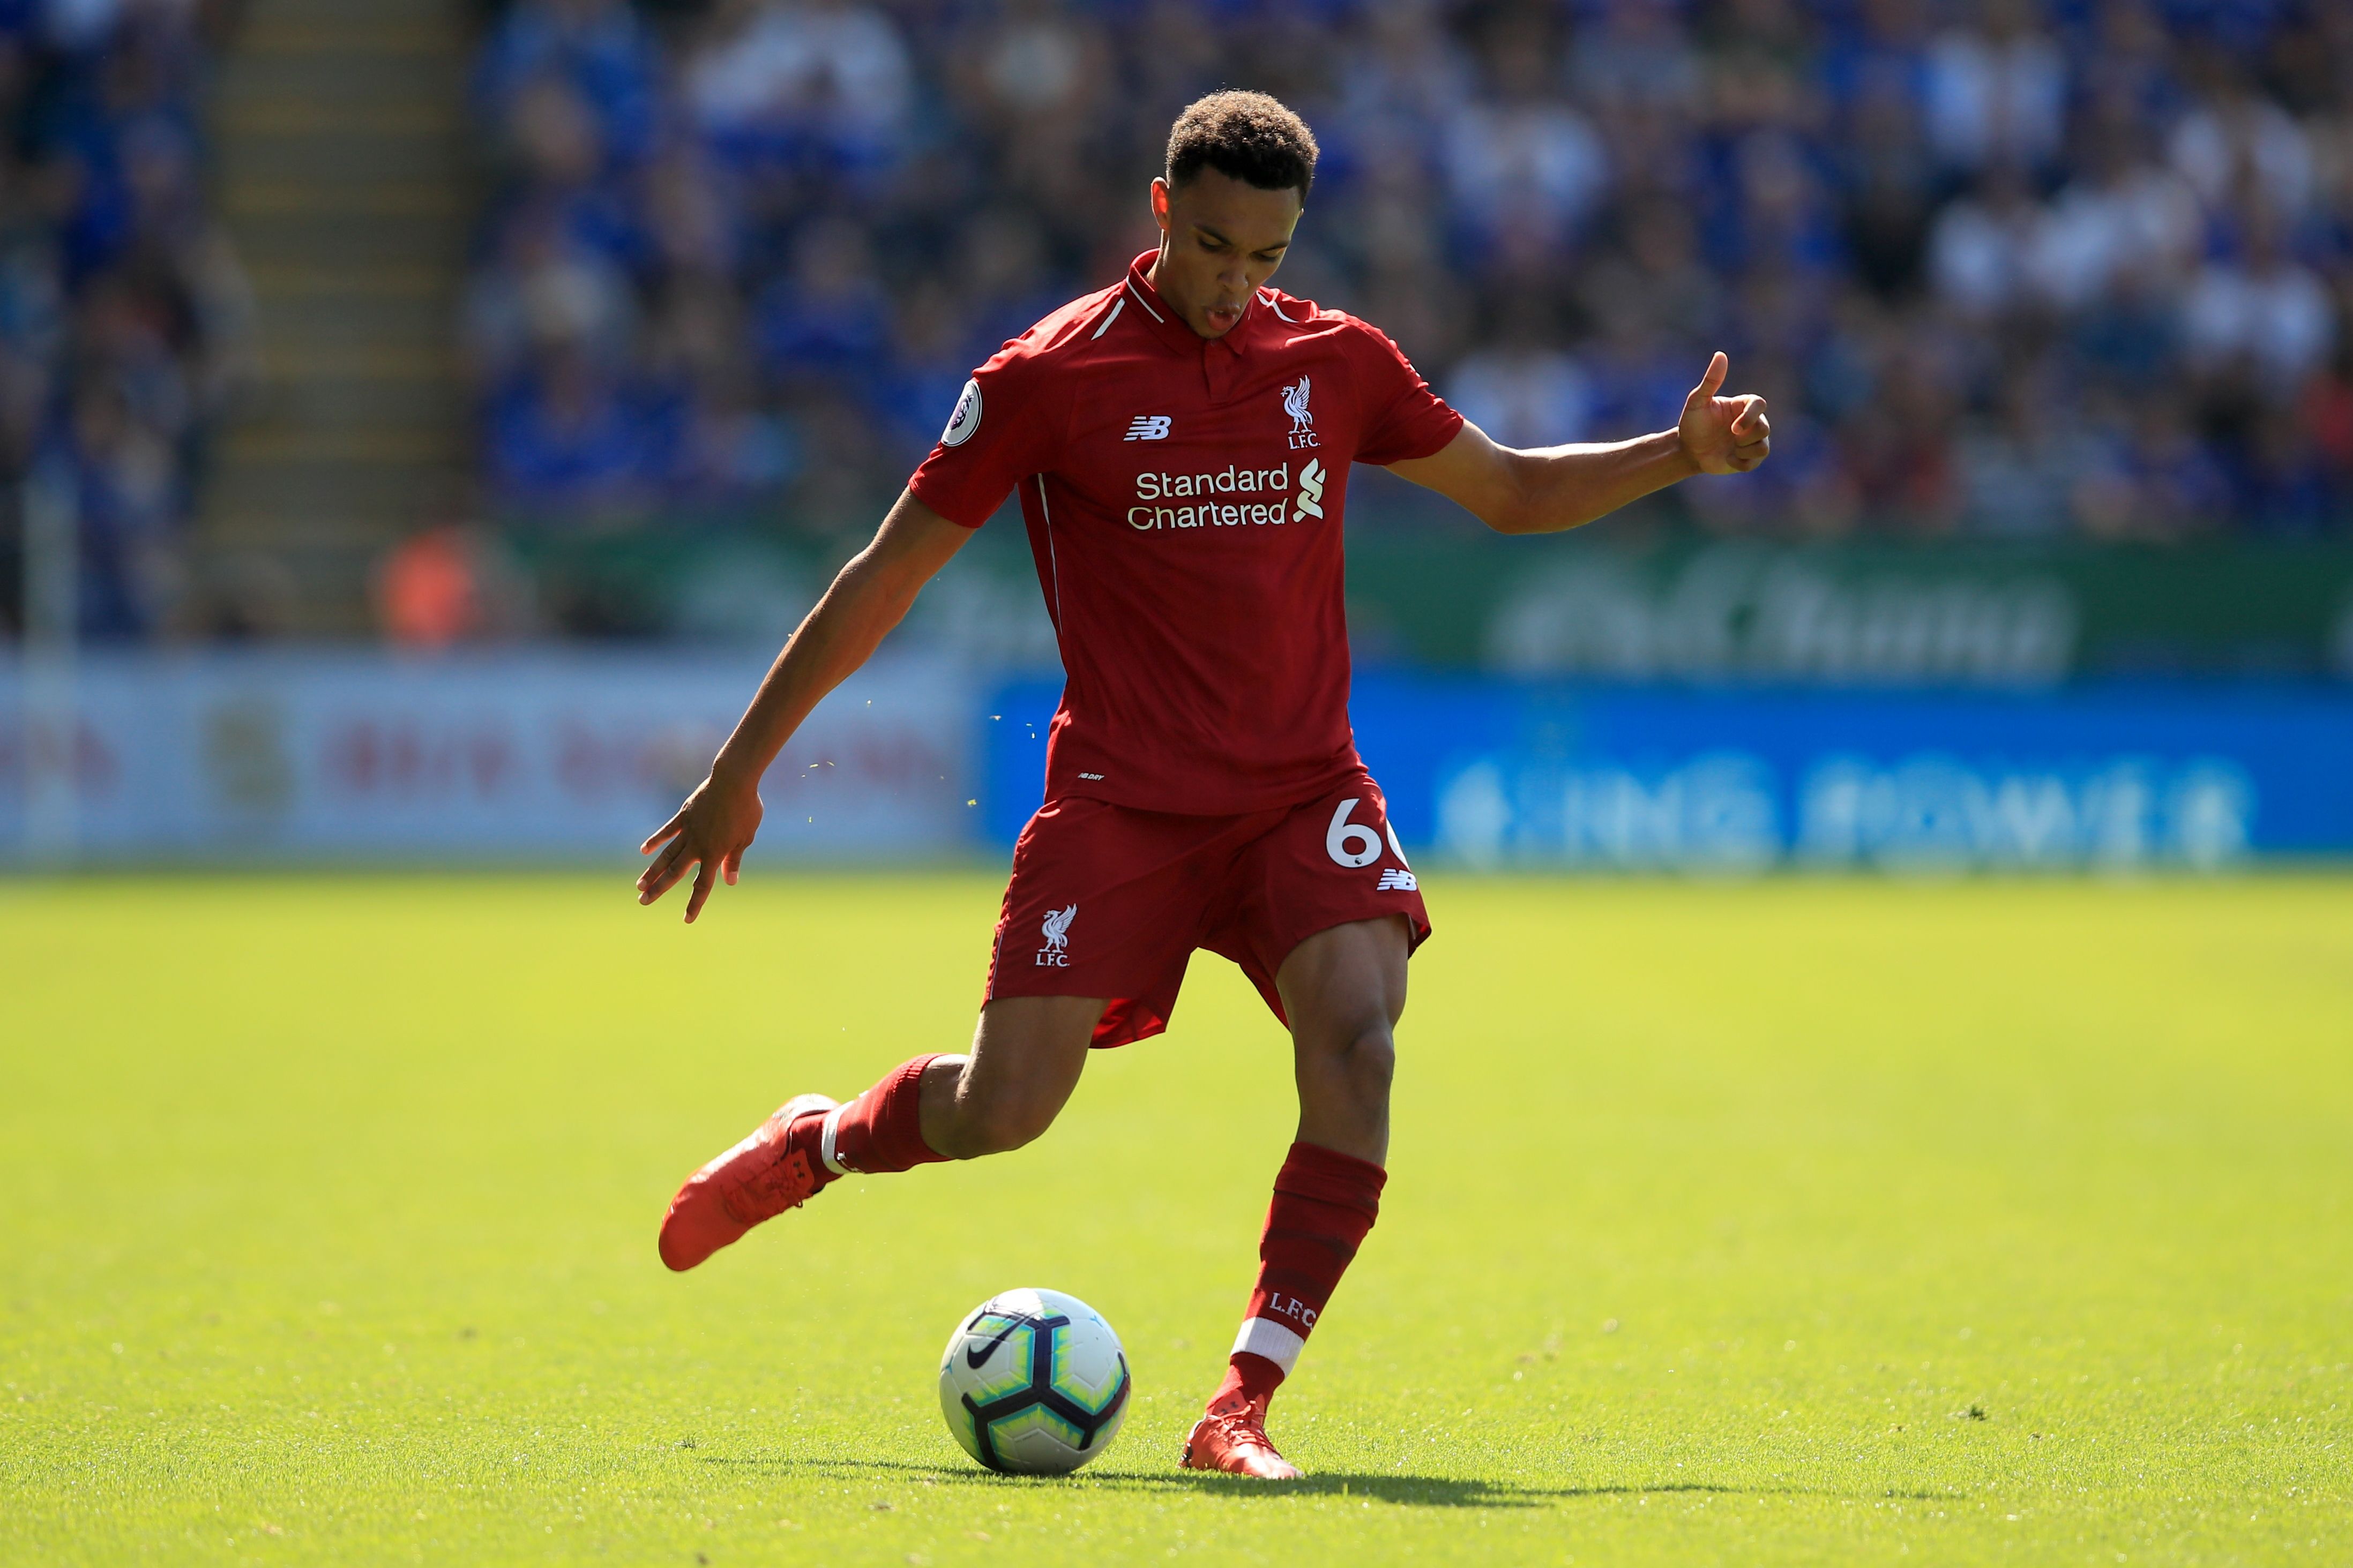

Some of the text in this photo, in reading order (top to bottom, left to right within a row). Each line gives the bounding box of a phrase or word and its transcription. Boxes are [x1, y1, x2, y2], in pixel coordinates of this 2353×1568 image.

[1124, 416, 1172, 441] NB
[1136, 462, 1289, 500] Standard
[1127, 497, 1288, 530] Chartered
[1377, 868, 1417, 891] NB
